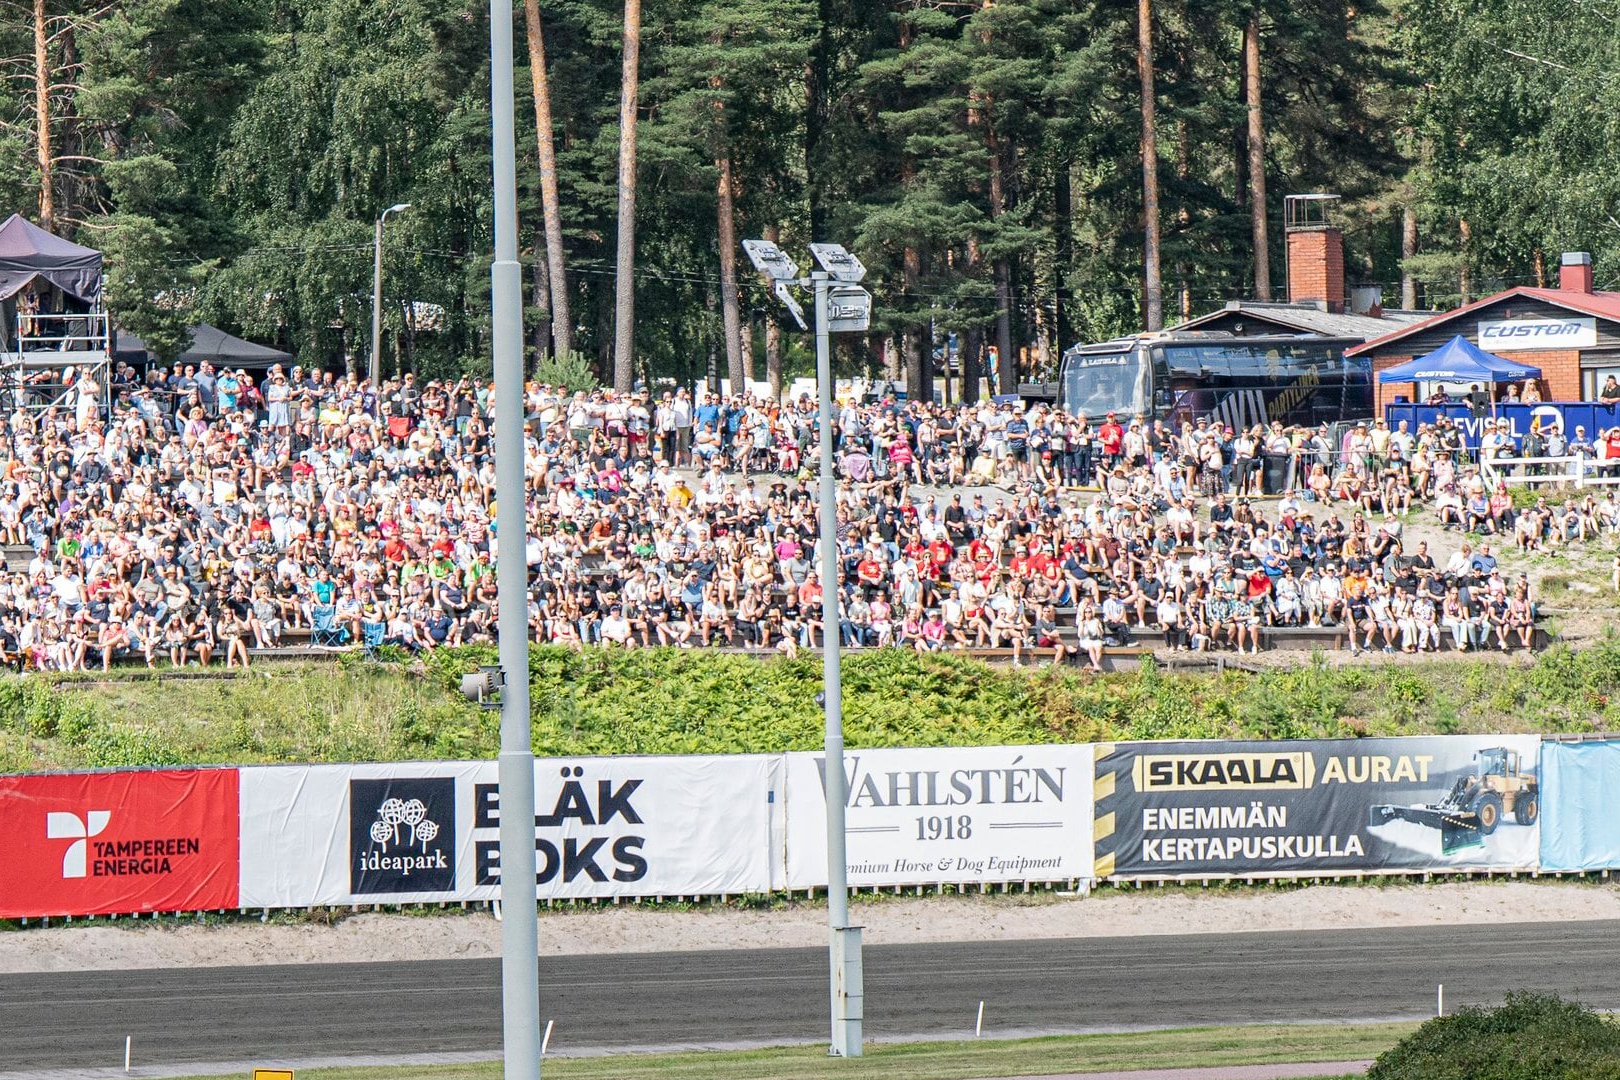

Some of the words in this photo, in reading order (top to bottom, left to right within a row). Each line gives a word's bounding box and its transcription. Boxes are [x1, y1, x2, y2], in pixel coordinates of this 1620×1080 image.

[1483, 323, 1582, 338] CUSTOM
[813, 755, 1067, 808] WAHLSTÉN
[1149, 758, 1297, 786] SKAALA
[1321, 755, 1434, 785] AURAT
[916, 814, 972, 841] 1918
[1143, 801, 1286, 831] ENEMMÄN
[94, 838, 200, 858] TAMPEREEN
[1143, 834, 1364, 861] KERTAPUSKULLA
[93, 857, 172, 877] ENERGIA
[360, 848, 448, 876] ideapark
[894, 858, 933, 874] Horse
[938, 857, 954, 871] &
[956, 856, 983, 874] Dog
[988, 854, 1062, 876] Equipment
